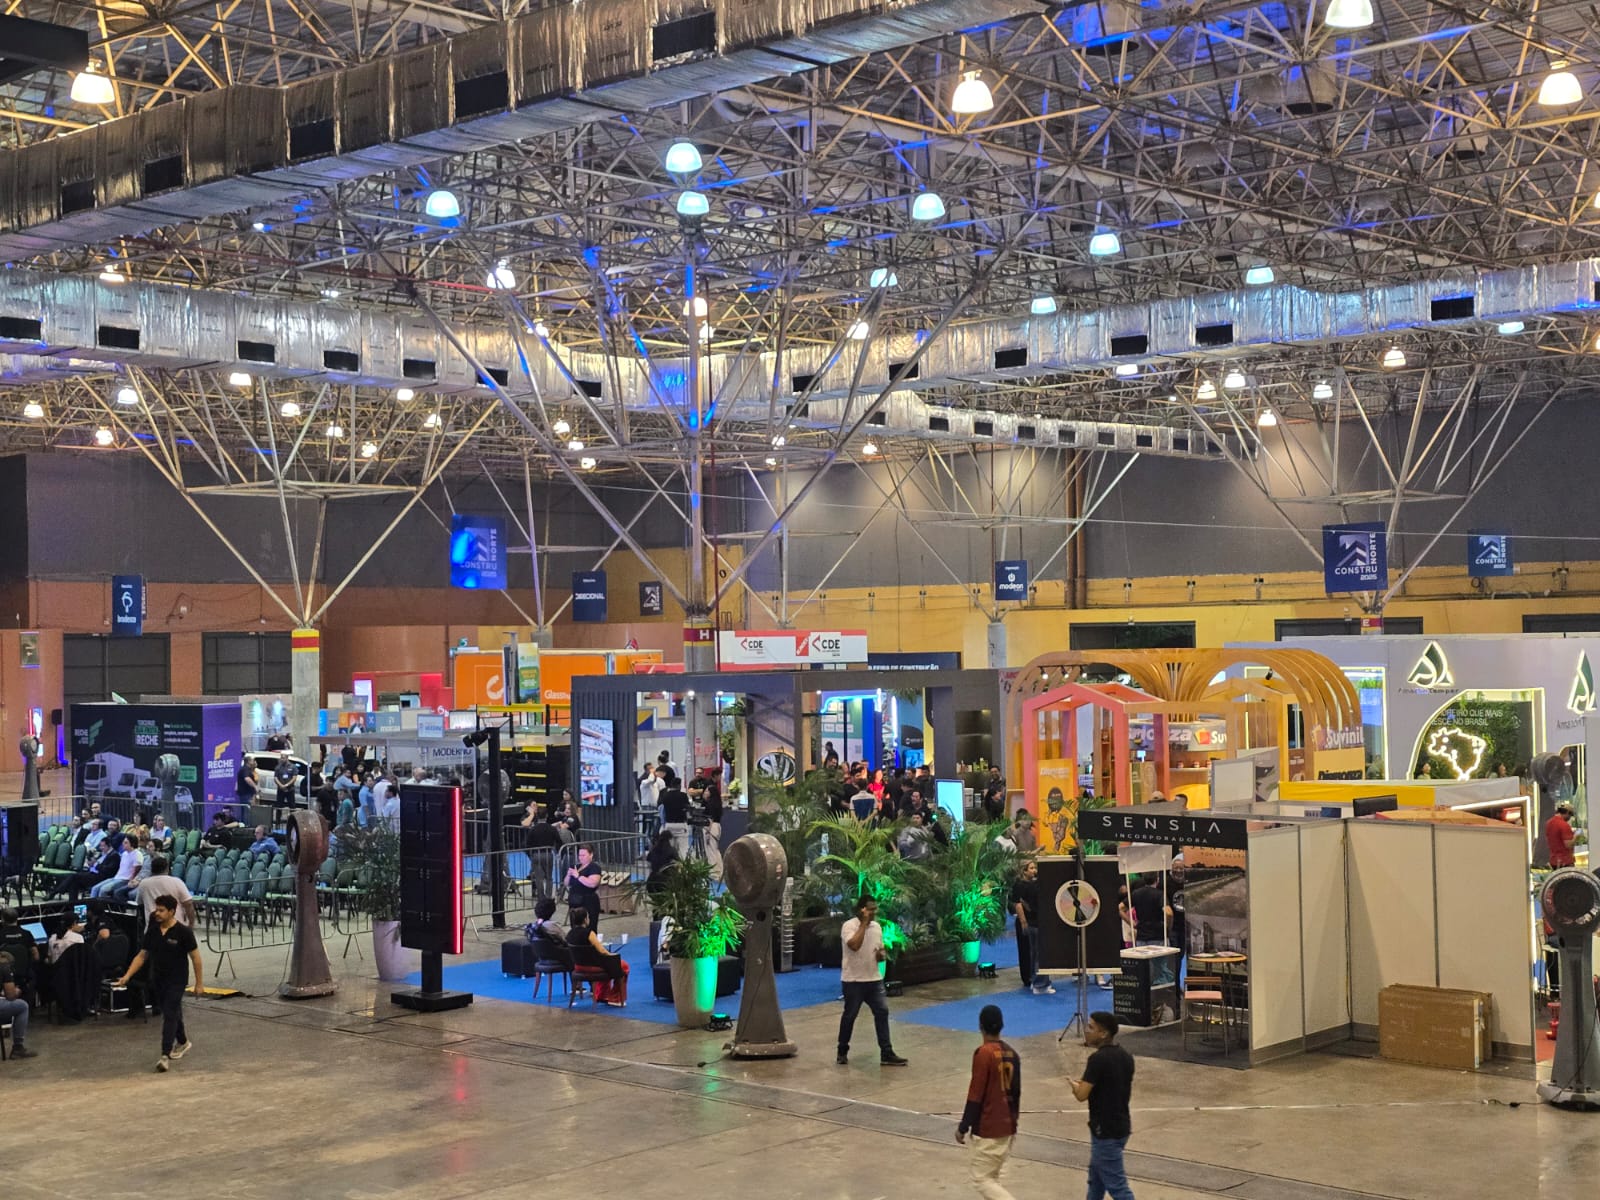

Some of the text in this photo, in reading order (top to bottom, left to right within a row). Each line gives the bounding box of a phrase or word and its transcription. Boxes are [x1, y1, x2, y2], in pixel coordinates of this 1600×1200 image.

[1369, 532, 1377, 565] NORTE
[1334, 565, 1378, 575] CONSTRU
[1362, 619, 1370, 627] E
[699, 630, 710, 640] H
[748, 640, 763, 649] CDE
[821, 638, 841, 650] CDE
[1469, 709, 1484, 717] QUE
[1485, 709, 1504, 718] MAIS
[1453, 718, 1464, 726] NO
[1465, 718, 1489, 726] BRASIL
[135, 734, 159, 746] RECHE
[207, 759, 234, 769] RECHE
[1102, 815, 1221, 834] SENSIA
[1115, 833, 1208, 844] INCORPORADORA
